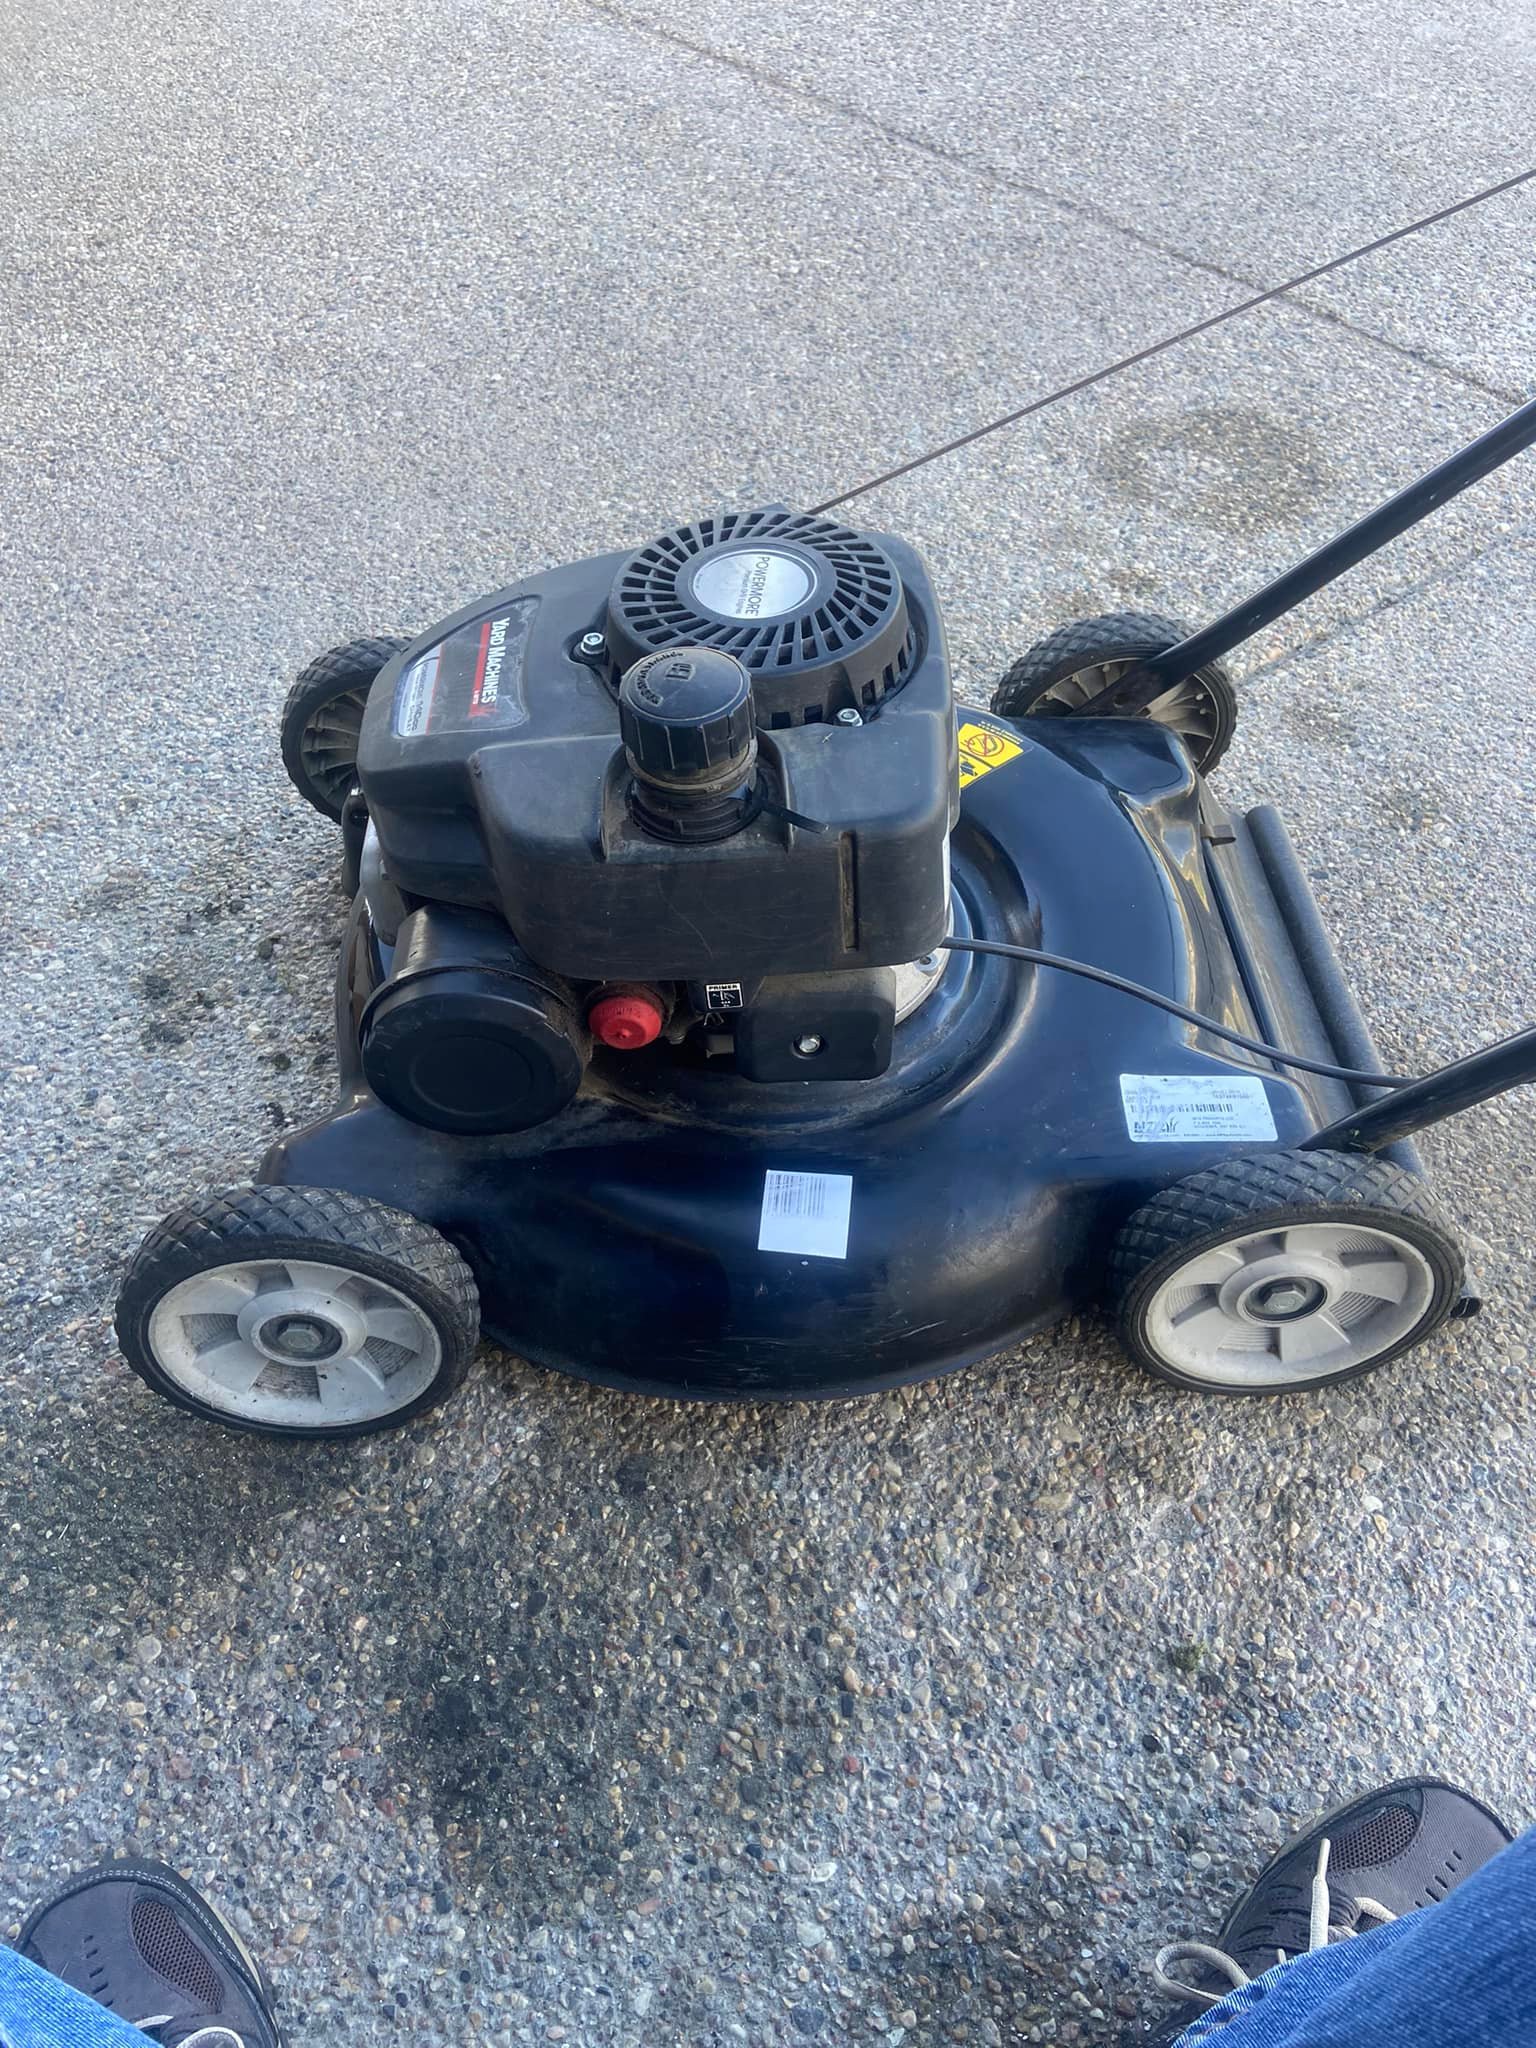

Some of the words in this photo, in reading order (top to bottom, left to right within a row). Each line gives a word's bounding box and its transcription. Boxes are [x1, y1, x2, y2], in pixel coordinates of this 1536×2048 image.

[745, 556, 770, 617] POWERMORE
[489, 617, 510, 646] YARD
[480, 646, 506, 704] MACHINES
